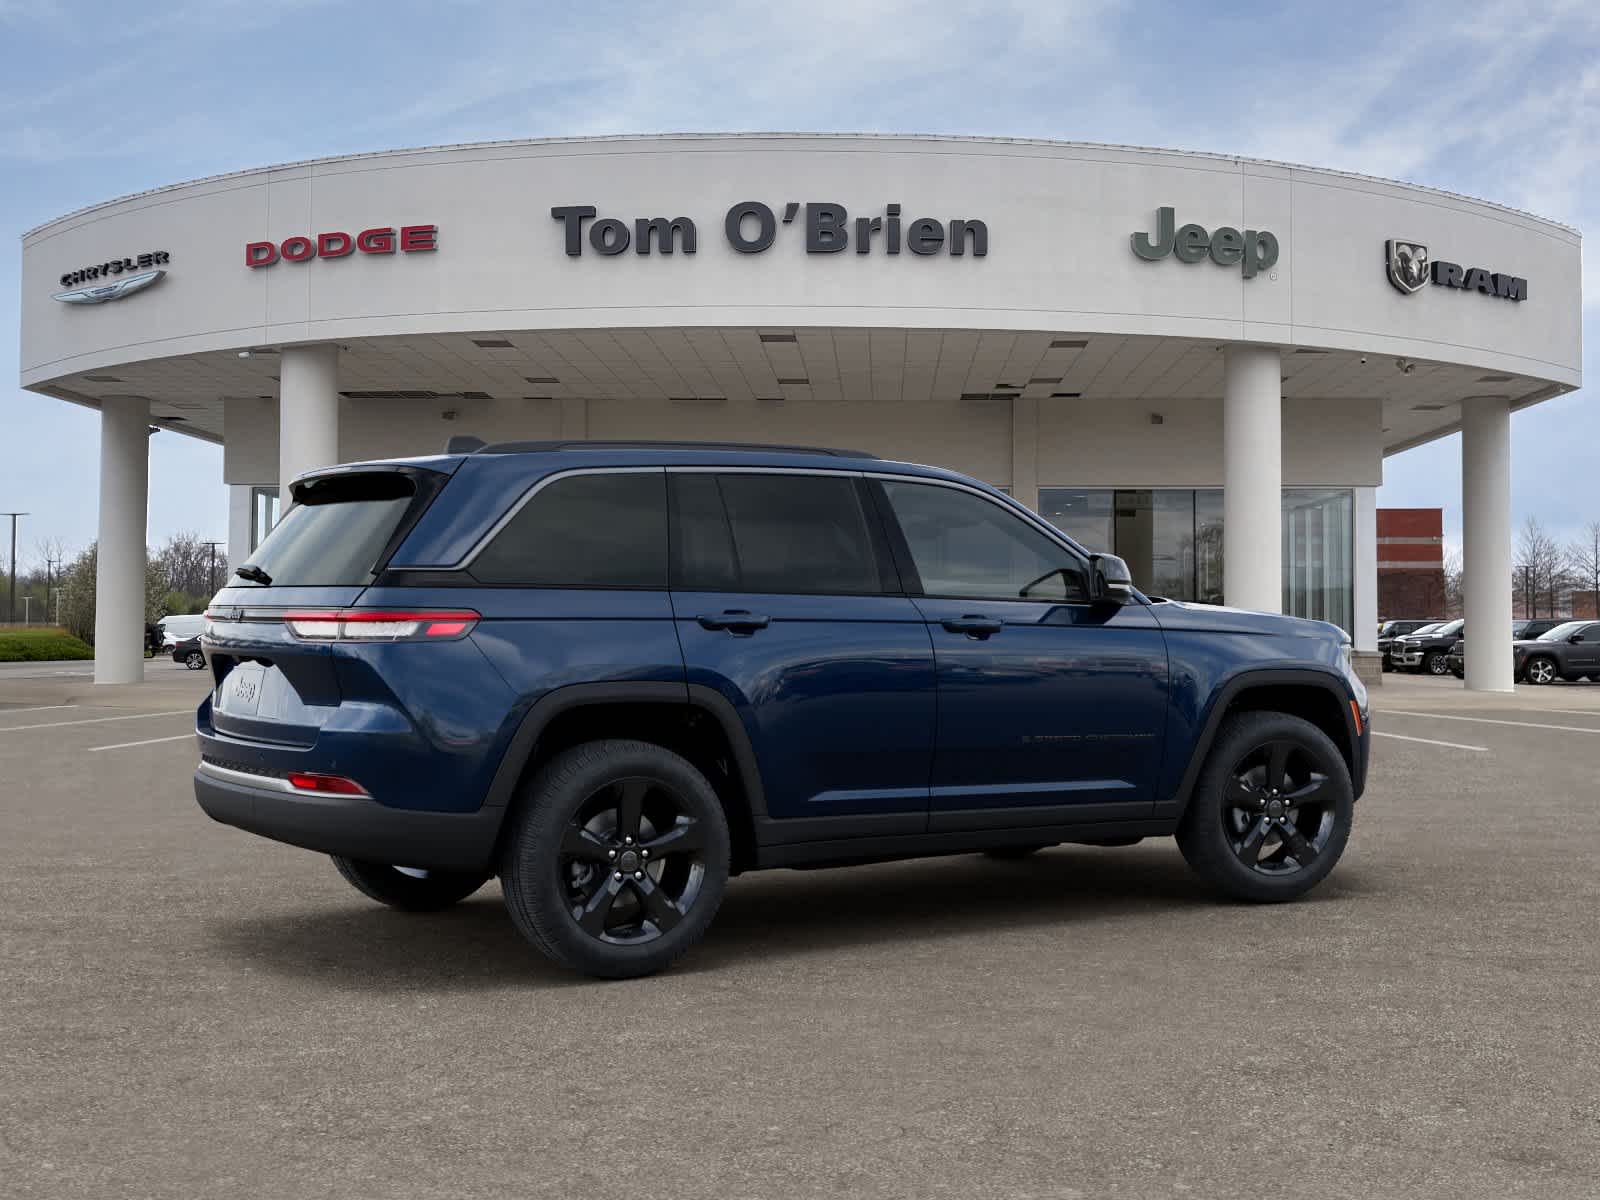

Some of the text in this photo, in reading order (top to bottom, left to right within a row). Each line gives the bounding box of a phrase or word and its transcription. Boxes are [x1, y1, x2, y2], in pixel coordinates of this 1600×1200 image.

[245, 224, 439, 269] DODGE
[551, 201, 988, 256] Tom O'Brien
[1130, 206, 1280, 280] Jeep
[59, 250, 170, 287] CHRYSLER
[1430, 260, 1528, 301] RAM
